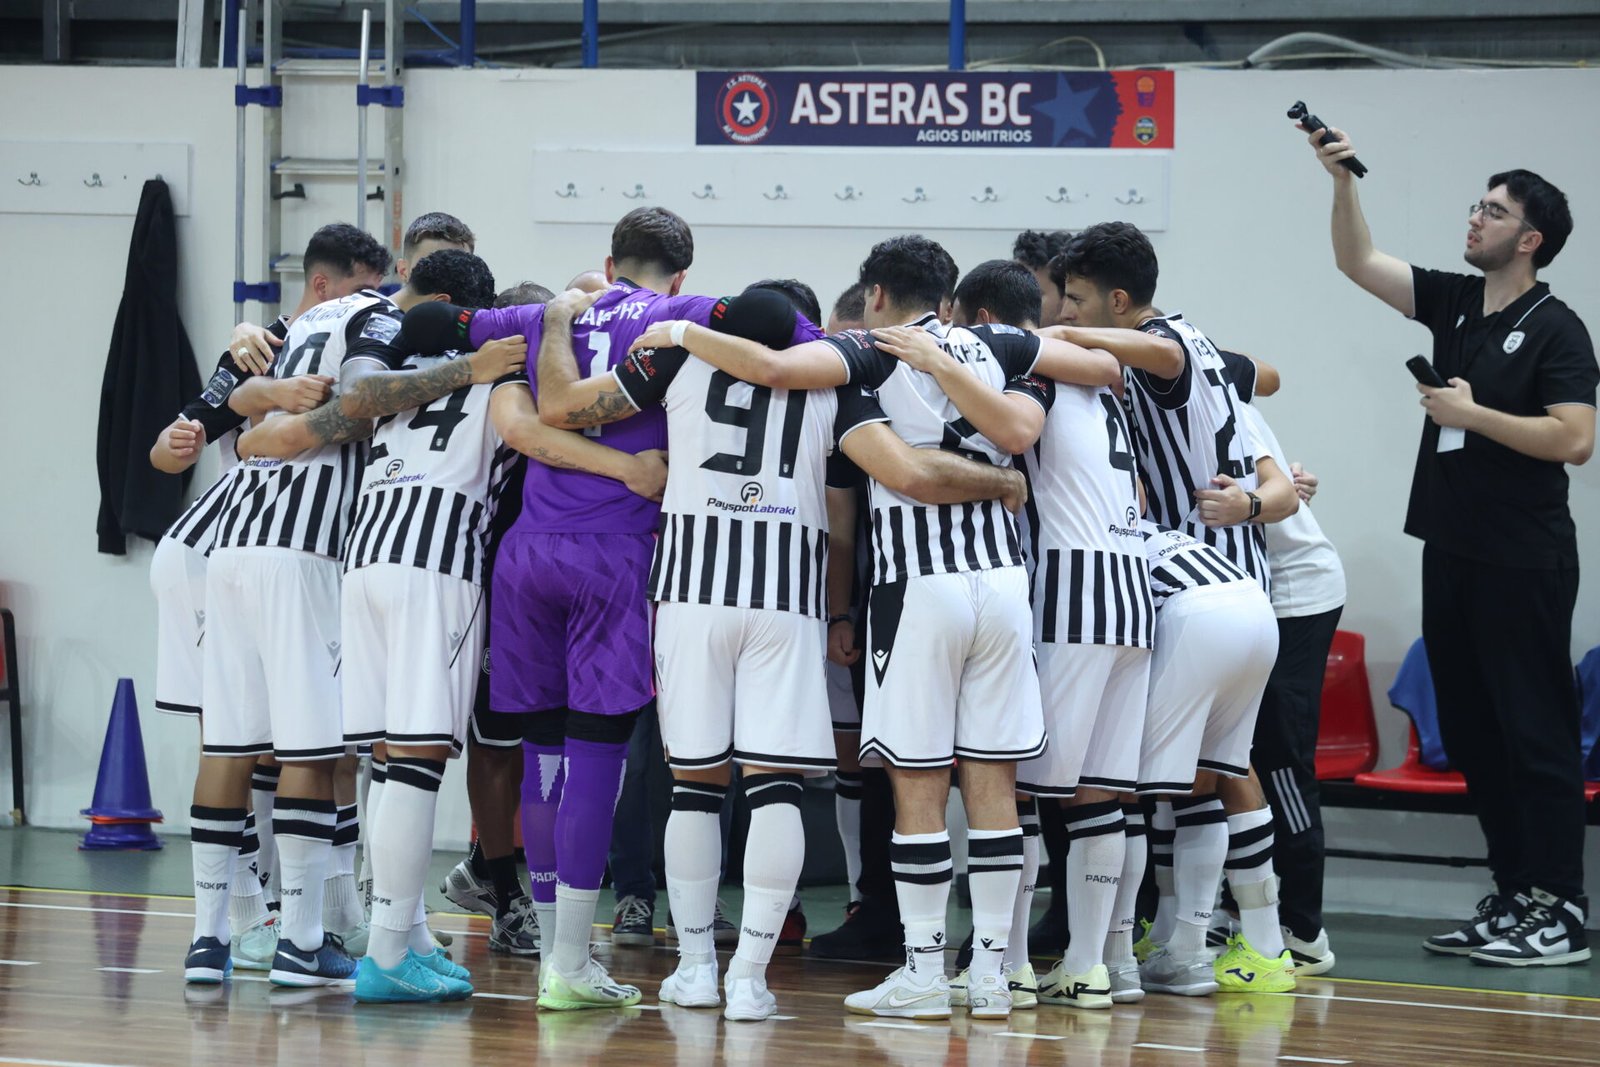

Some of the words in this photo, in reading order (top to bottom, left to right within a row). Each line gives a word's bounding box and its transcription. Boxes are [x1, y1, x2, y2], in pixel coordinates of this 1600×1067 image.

[790, 83, 968, 125] ASTERAS
[981, 83, 1032, 125] BC
[916, 129, 959, 143] AGIOS
[961, 129, 1032, 143] DIMITRIOS
[699, 369, 808, 479] 91
[706, 497, 796, 516] PayspotLabraki
[530, 869, 559, 883] PAOK
[1085, 873, 1112, 885] PAOK
[685, 926, 706, 935] PAOK
[743, 926, 763, 938] PAOK
